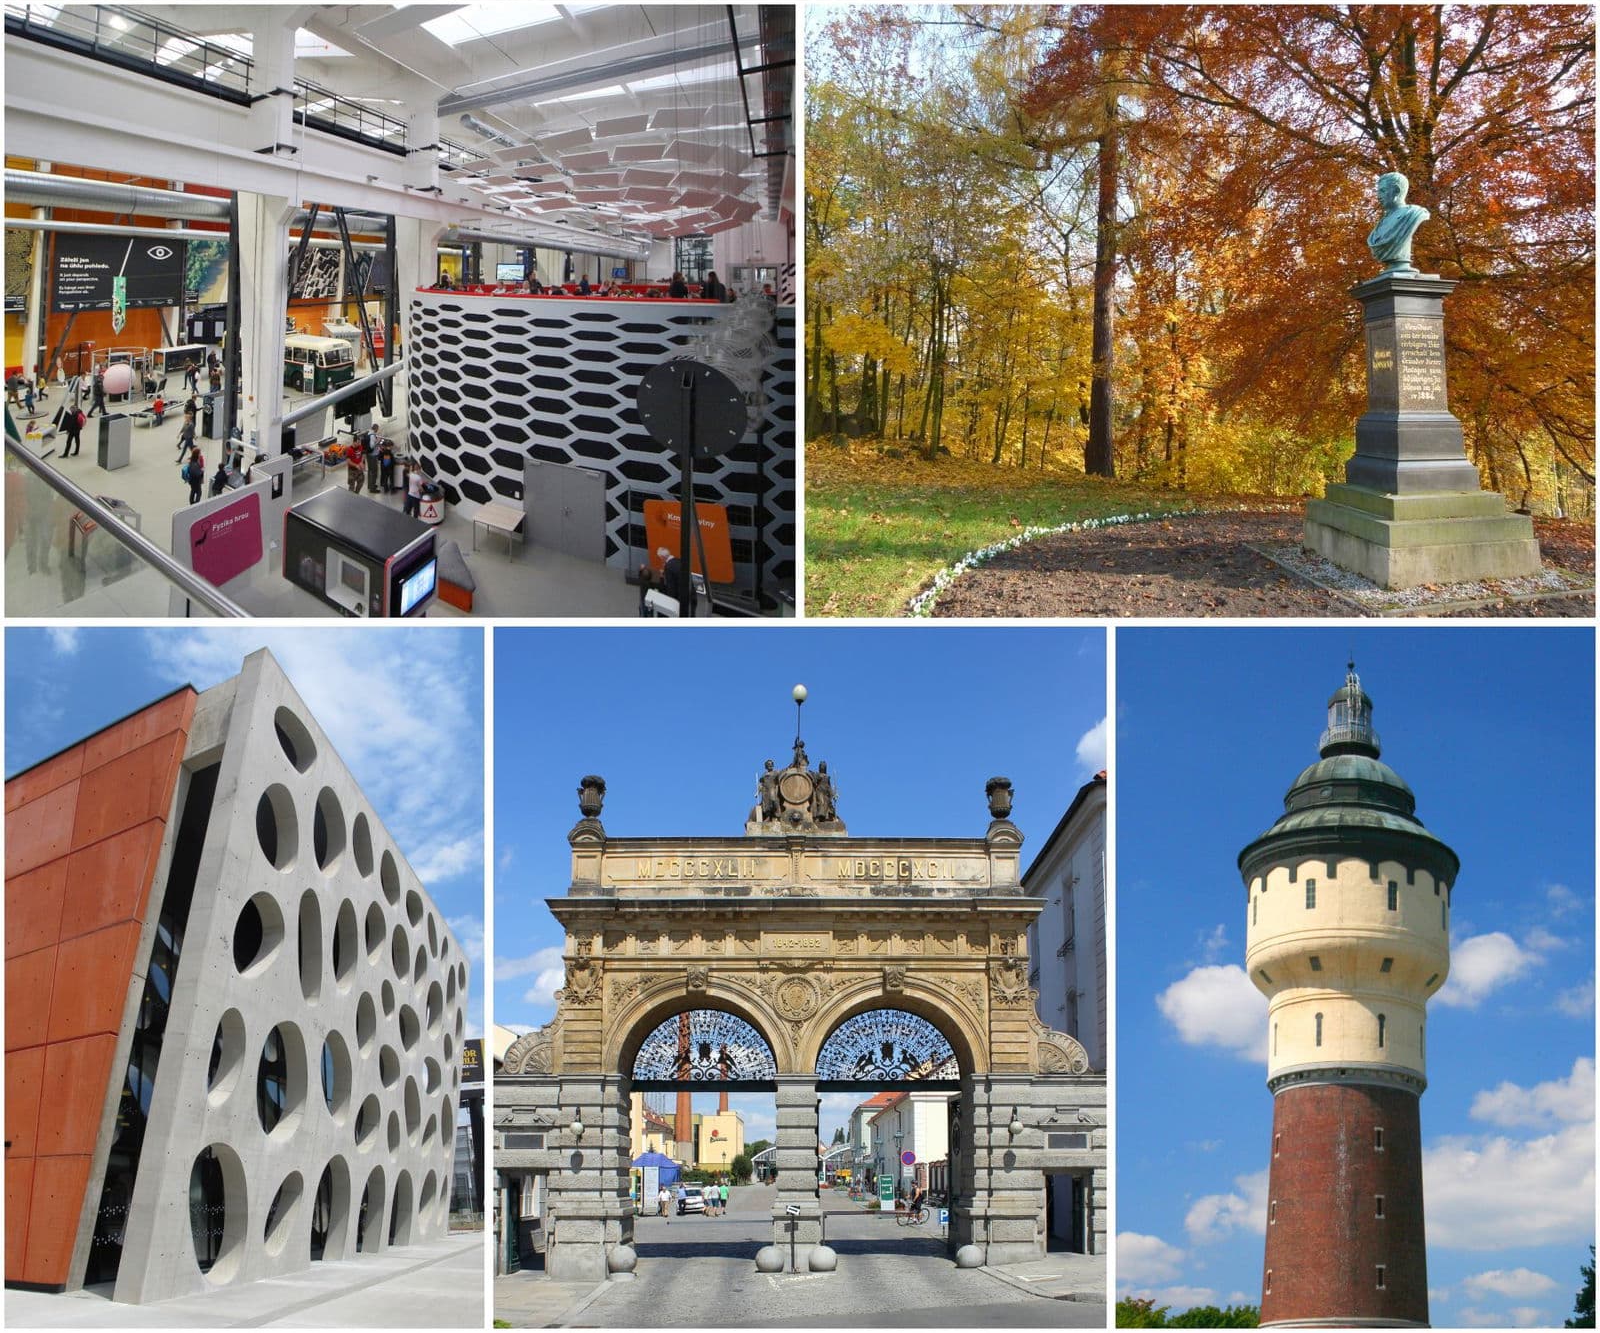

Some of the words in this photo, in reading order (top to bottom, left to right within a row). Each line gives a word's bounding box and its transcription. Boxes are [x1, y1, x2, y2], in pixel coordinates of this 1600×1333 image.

[212, 519, 234, 532] Fyzika
[234, 512, 249, 523] hrou
[838, 859, 955, 878] MDCCCXCII
